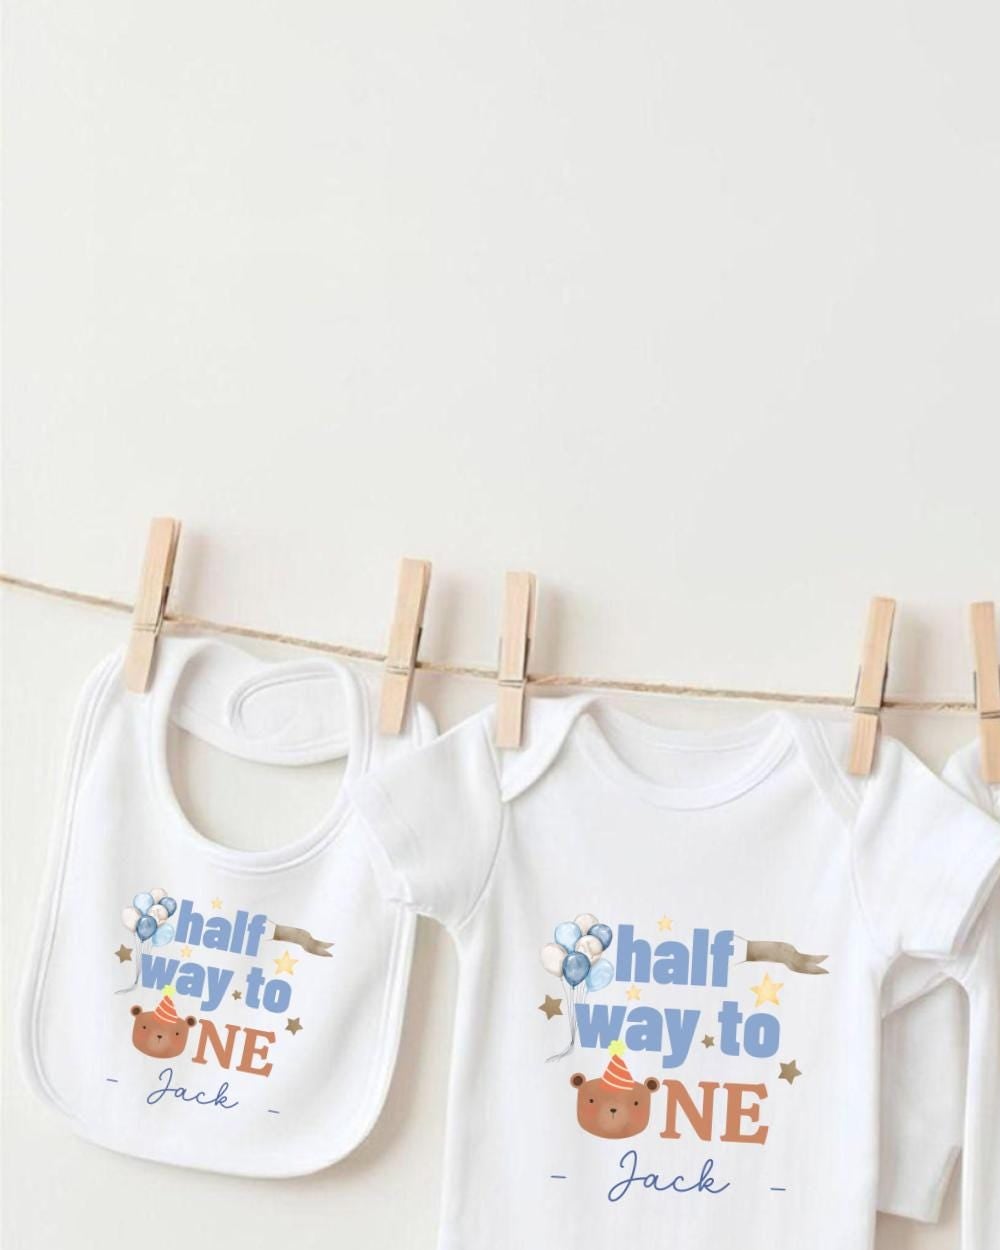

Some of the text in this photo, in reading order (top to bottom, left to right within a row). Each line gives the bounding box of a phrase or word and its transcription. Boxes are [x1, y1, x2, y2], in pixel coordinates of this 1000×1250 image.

[174, 899, 267, 957] half
[615, 924, 735, 988] half
[141, 954, 292, 1014] way to
[575, 1001, 780, 1069] way to
[147, 1068, 239, 1109] Jack
[608, 1150, 730, 1202] Jack
